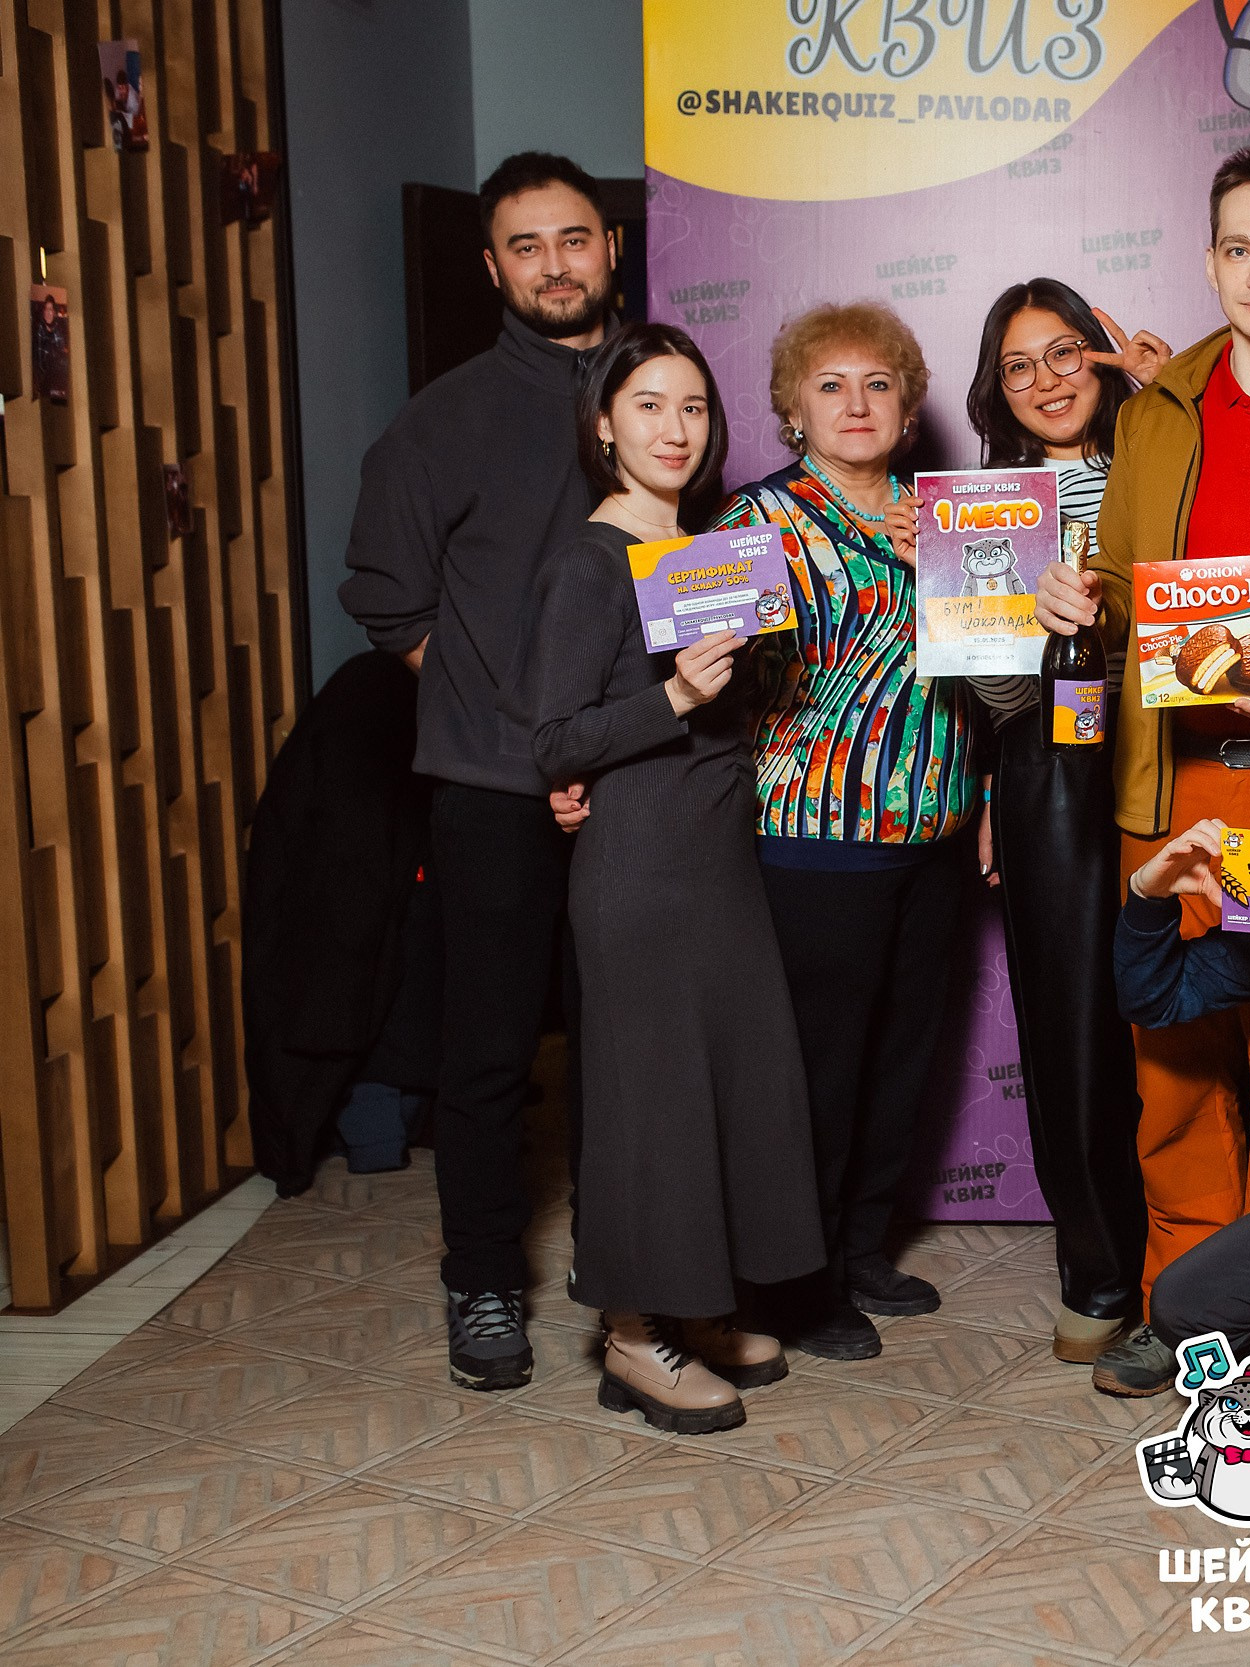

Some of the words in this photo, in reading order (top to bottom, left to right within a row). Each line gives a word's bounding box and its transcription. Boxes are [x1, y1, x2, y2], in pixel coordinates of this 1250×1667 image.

[677, 88, 1072, 124] @SHAKERQUIZ_PAVLODAR
[1007, 157, 1062, 179] КВИЗ
[1082, 227, 1164, 253] ШЕЙКЕР
[876, 254, 958, 279] ШЕЙКЕР
[1096, 253, 1152, 274] КВИЗ
[669, 280, 750, 304] ШЕЙКЕР
[891, 278, 946, 300] КВИЗ
[684, 304, 740, 326] КВИЗ
[952, 482, 992, 494] ШЕЙКЕР
[994, 481, 1021, 492] КВИЗ
[936, 502, 949, 530] 1
[958, 502, 1040, 530] МЕСТО
[729, 533, 773, 549] ШЕЙКЕР
[738, 545, 768, 559] КВИЗ
[667, 560, 753, 585] СЕРТИФИКАТ
[1196, 566, 1243, 579] ORION
[677, 585, 689, 594] НА
[691, 580, 723, 593] СКИДКУ
[727, 574, 750, 586] 50%
[960, 614, 1041, 631] ШОКОЛАДК
[1080, 695, 1101, 703] КВИЗ
[1158, 693, 1170, 703] 12
[943, 1184, 995, 1205] КВИЗ
